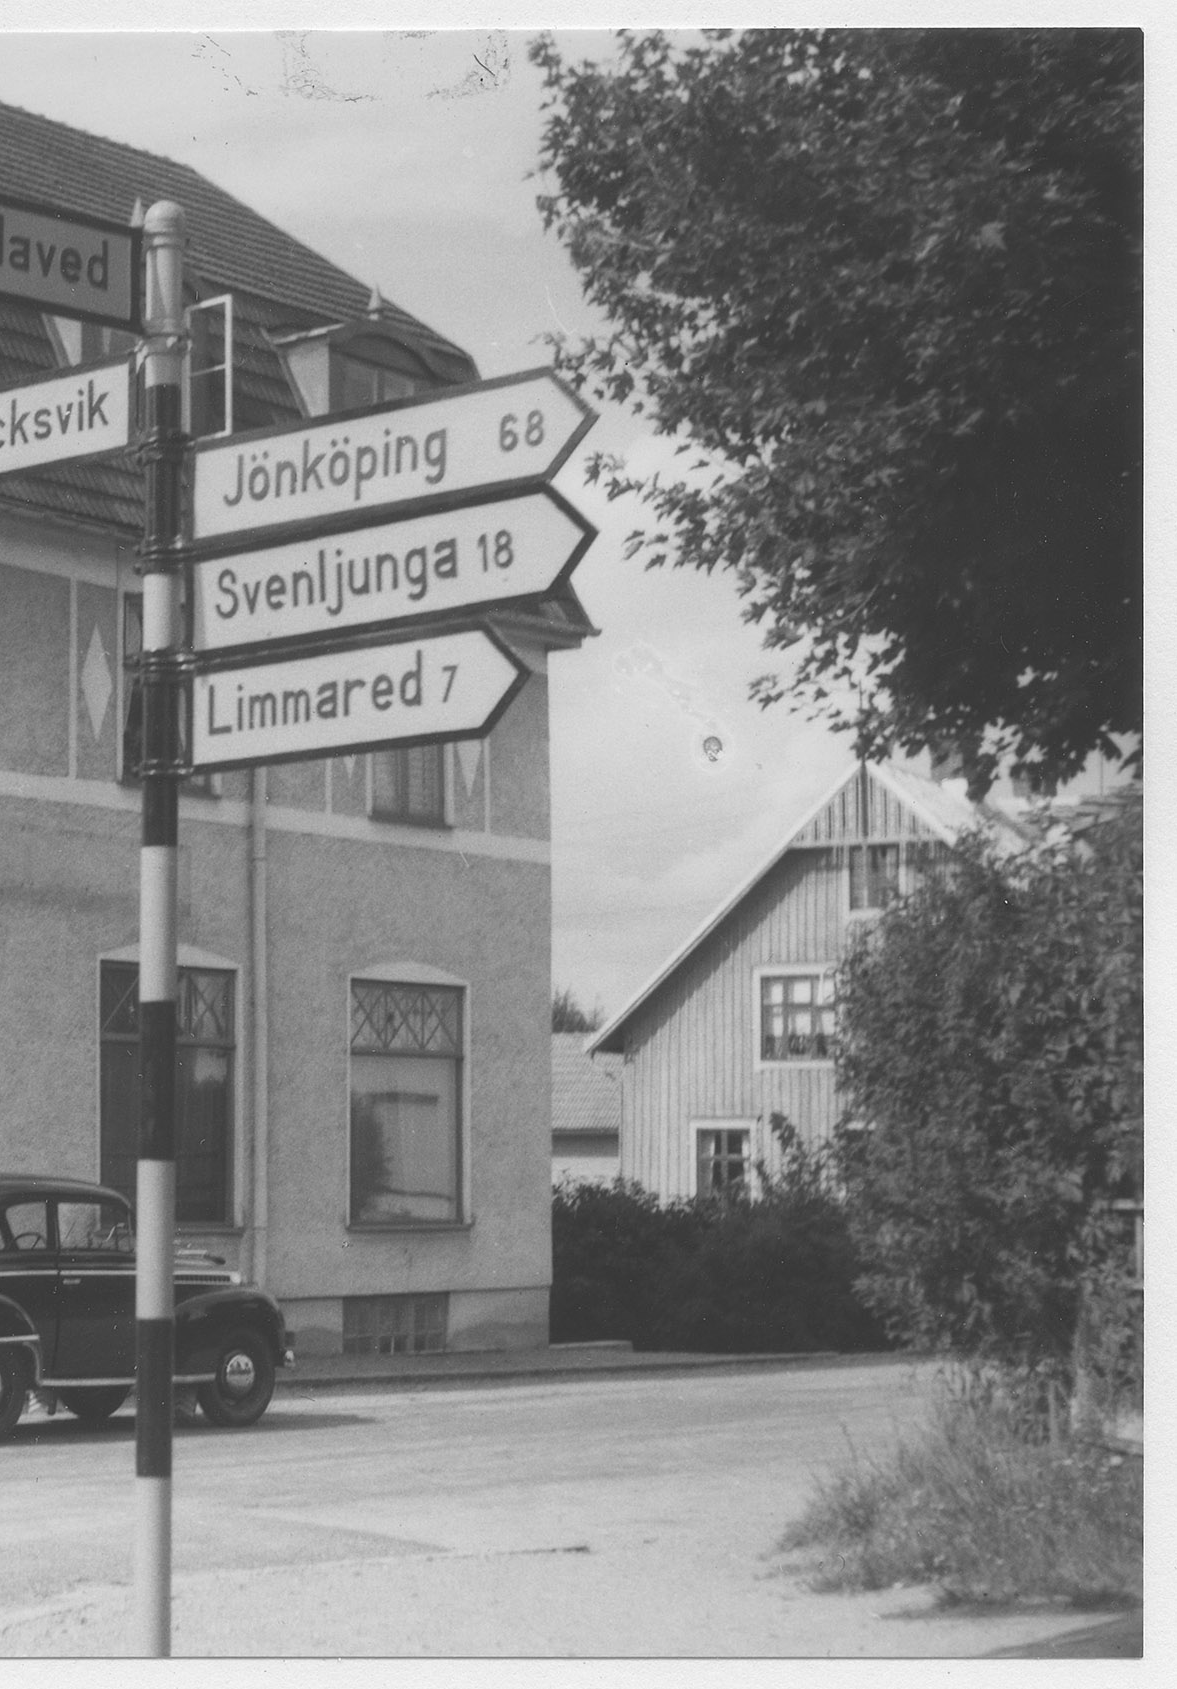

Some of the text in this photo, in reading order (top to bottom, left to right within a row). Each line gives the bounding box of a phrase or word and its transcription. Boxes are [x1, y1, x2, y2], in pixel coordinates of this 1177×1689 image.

[223, 410, 545, 507] Jönköping 68
[215, 529, 514, 619] Svenljunga 18
[208, 649, 459, 736] Limmared 7
